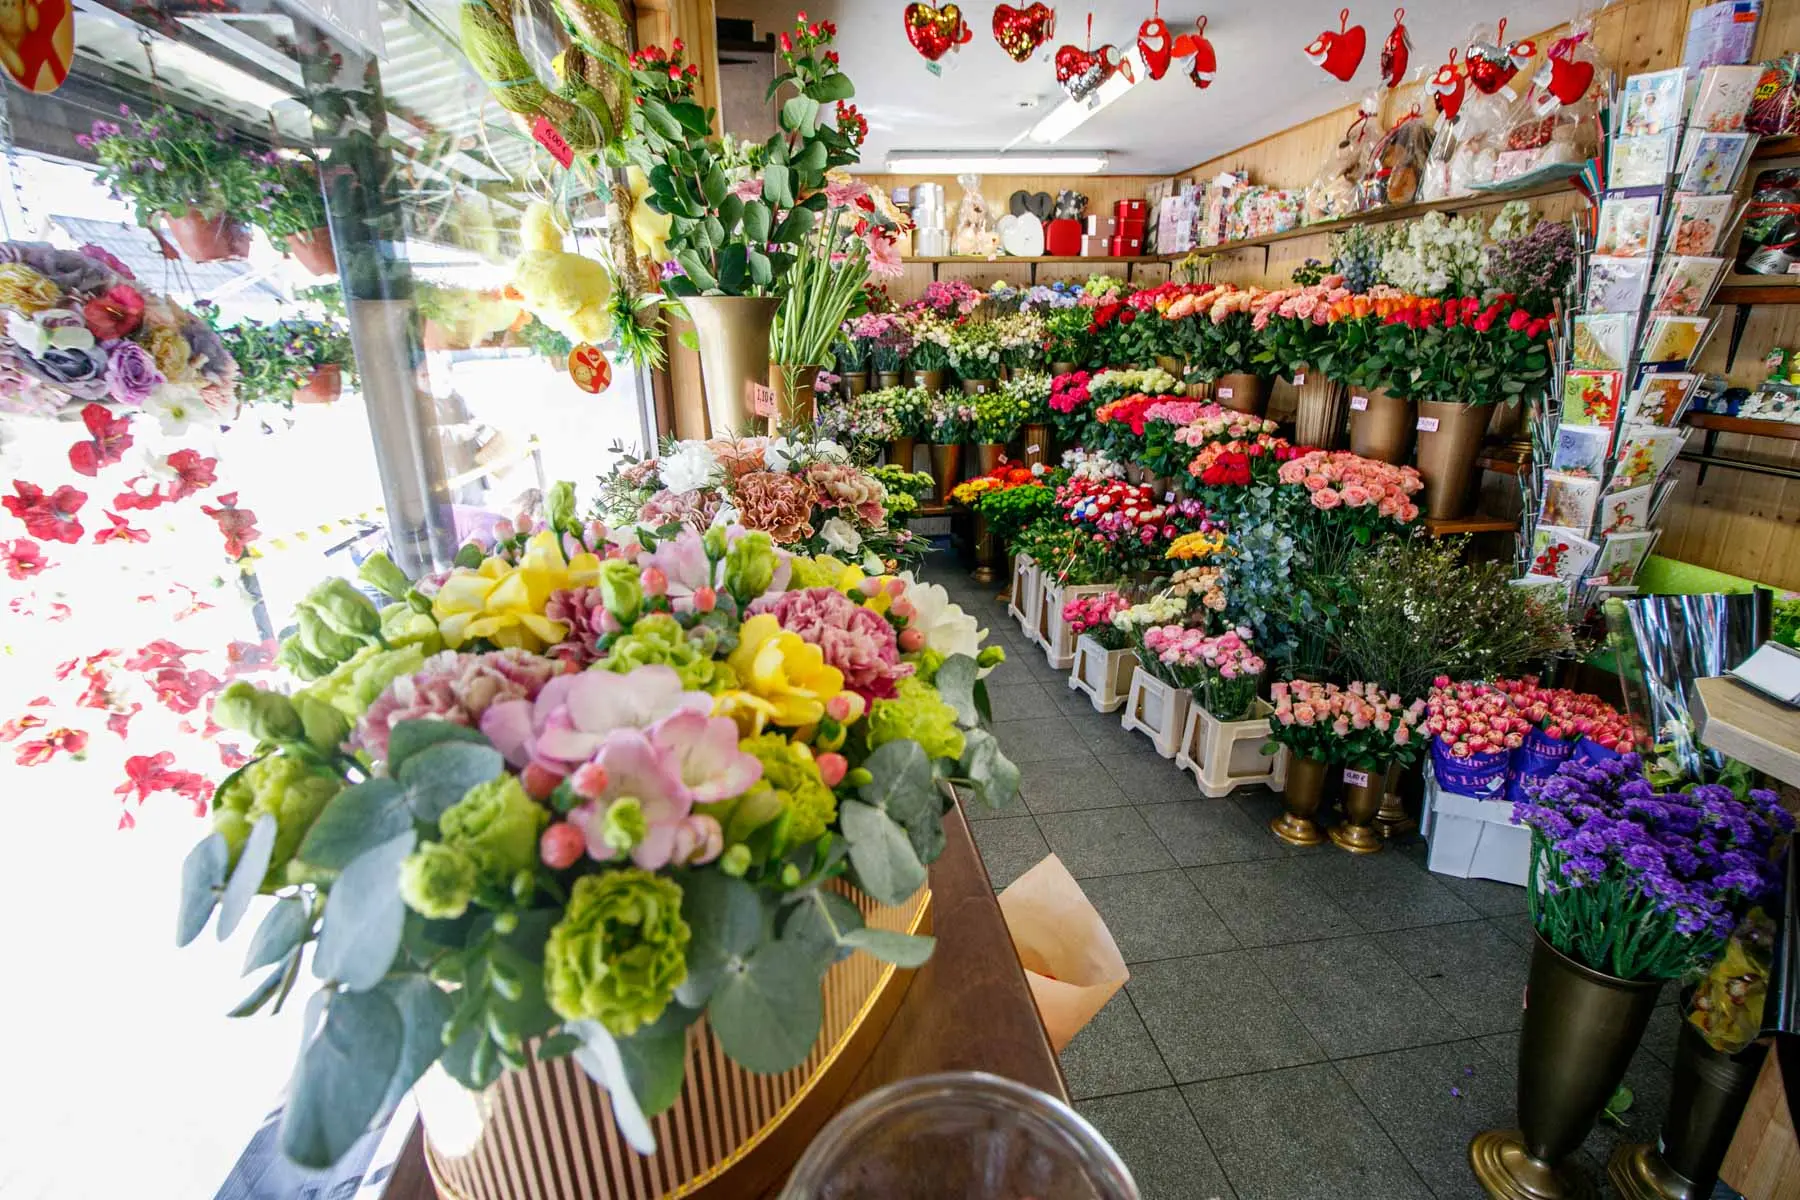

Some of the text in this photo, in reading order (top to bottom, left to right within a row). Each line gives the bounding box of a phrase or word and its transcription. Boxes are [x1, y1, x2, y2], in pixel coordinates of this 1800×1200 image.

[757, 388, 775, 406] 1,10 €
[1461, 771, 1504, 785] Lim
